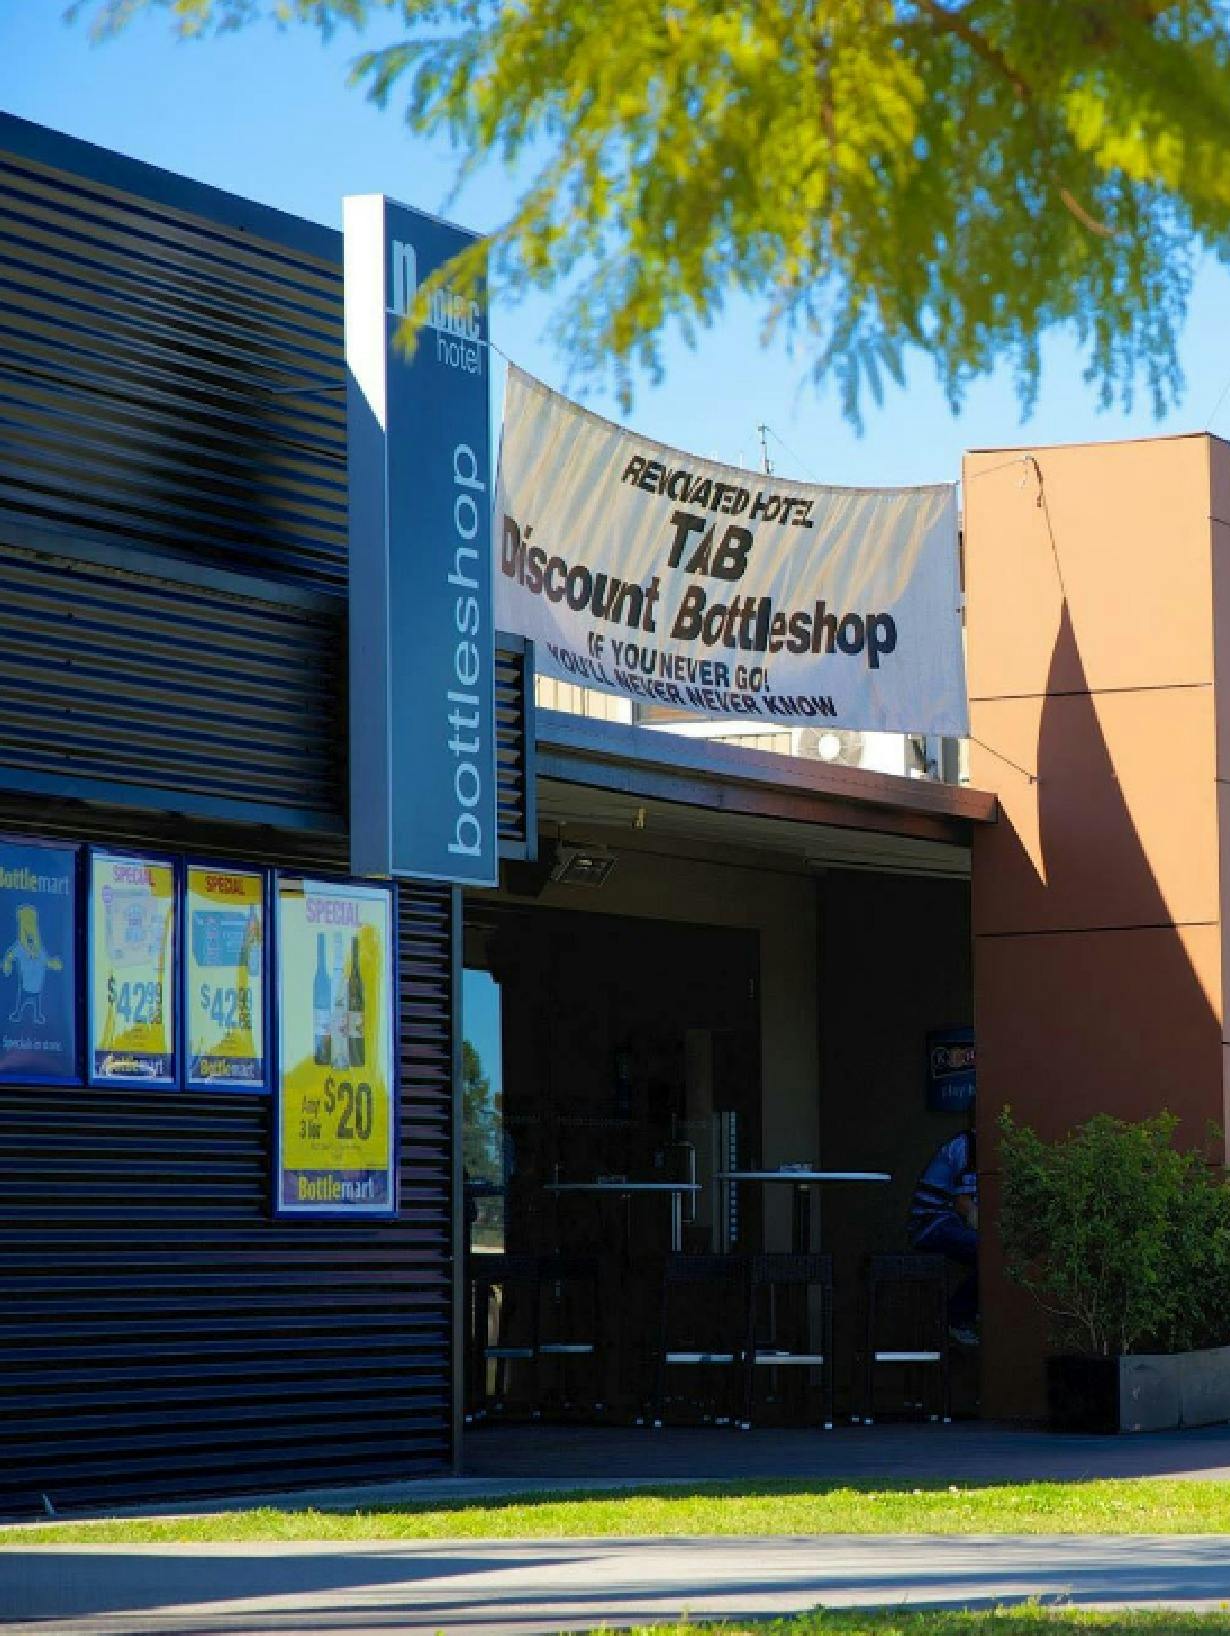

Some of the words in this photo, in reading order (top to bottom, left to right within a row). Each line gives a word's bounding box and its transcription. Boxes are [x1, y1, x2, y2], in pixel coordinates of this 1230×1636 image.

[437, 331, 482, 376] hotel
[621, 455, 750, 516] RENOVATED
[748, 491, 815, 529] HOTEL
[667, 510, 754, 583] TAB
[501, 513, 662, 634] Discount
[669, 584, 898, 669] Bottleshop
[447, 443, 486, 857] bottleshop
[587, 630, 605, 657] IF
[611, 639, 658, 675] YOU
[658, 651, 730, 688] NEVER
[734, 665, 770, 693] GO!
[613, 668, 687, 706] NEVER
[685, 685, 763, 715] NEVER
[761, 695, 838, 718] KNOW
[305, 898, 362, 927] SPECIAL
[323, 1074, 373, 1141] $20
[298, 1174, 376, 1201] Bottlemart
